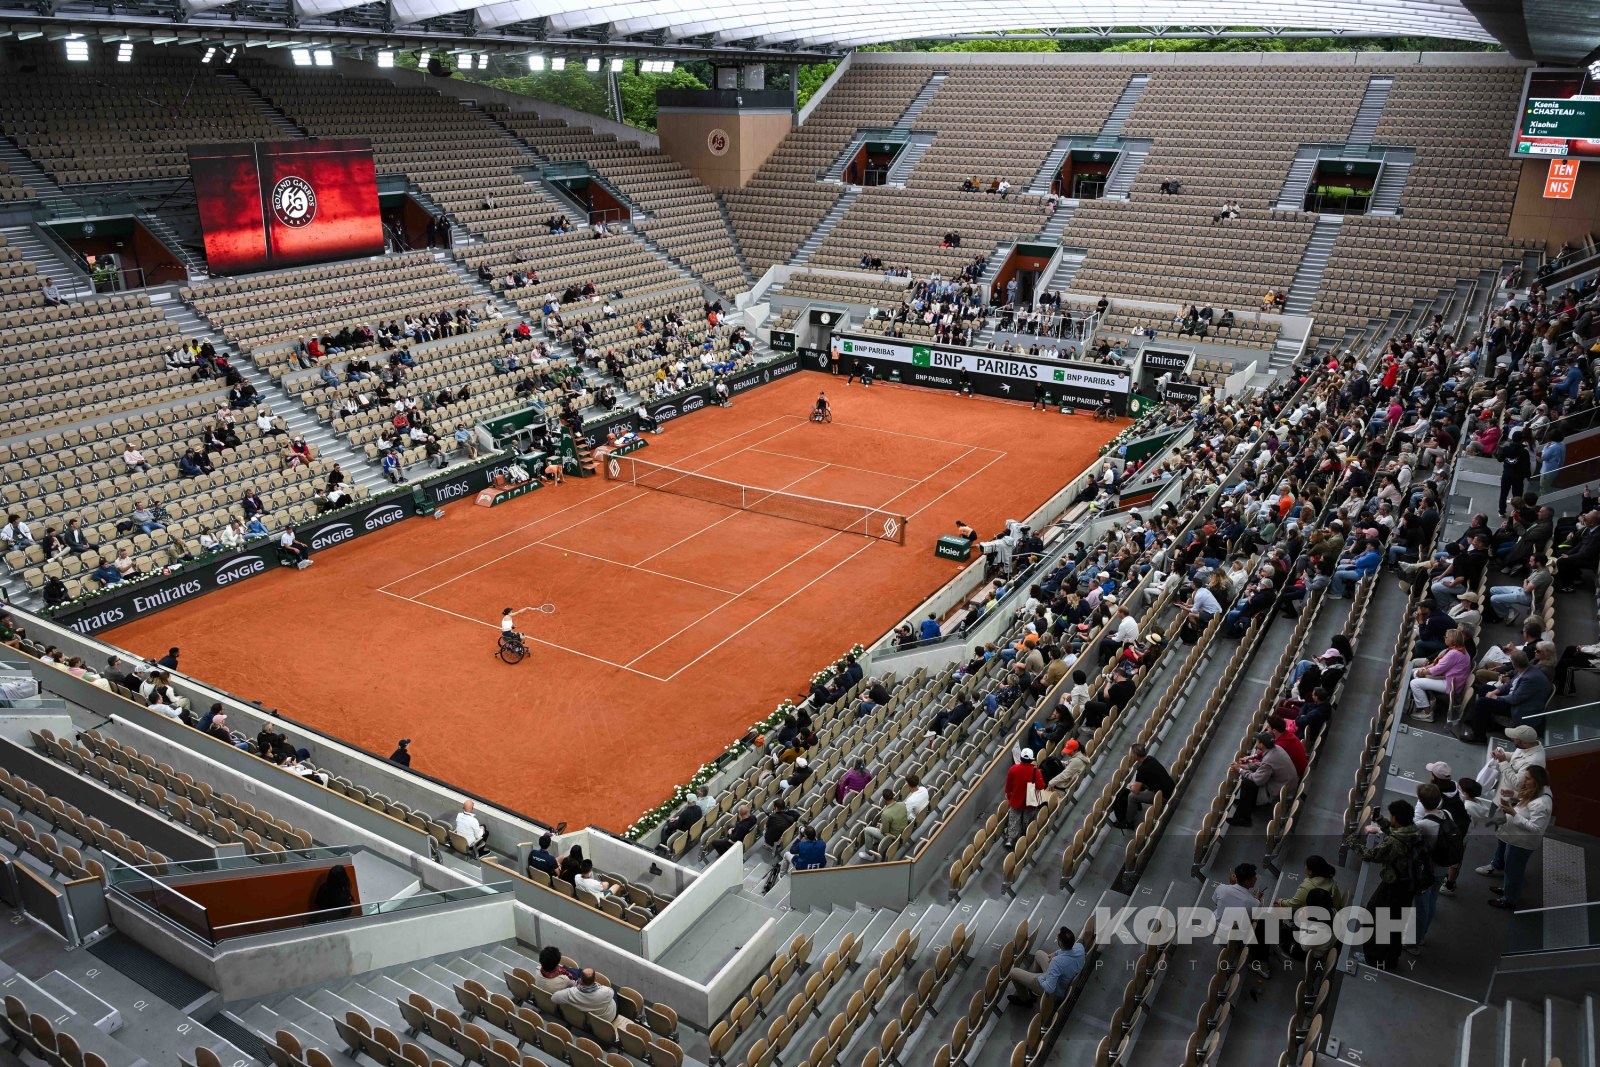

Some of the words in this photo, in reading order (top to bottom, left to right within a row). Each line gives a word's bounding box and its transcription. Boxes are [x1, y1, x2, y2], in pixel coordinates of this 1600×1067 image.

[1554, 164, 1574, 175] TEN
[1550, 182, 1569, 193] NIS
[274, 180, 291, 210] ROLAND
[293, 180, 315, 207] GARROS
[284, 214, 310, 224] PARIS
[868, 346, 895, 356] PARIBAS
[934, 353, 962, 368] BNP
[977, 358, 1038, 378] PARIBAS
[1145, 354, 1186, 367] Emirates
[774, 362, 797, 376] RENAULT
[734, 376, 760, 391] RENAULT
[928, 375, 952, 384] PARIBAS
[1067, 373, 1082, 381] BNP
[1084, 376, 1115, 386] PARIBAS
[1166, 390, 1198, 401] Emirates
[436, 481, 469, 501] Infosys
[940, 546, 960, 556] Haier
[133, 579, 201, 612] Emirates
[86, 969, 101, 979] 10
[1364, 971, 1377, 982] 16
[134, 1000, 149, 1011] 10
[55, 1015, 69, 1025] 11
[177, 1024, 192, 1035] 10
[1348, 1048, 1362, 1061] 16
